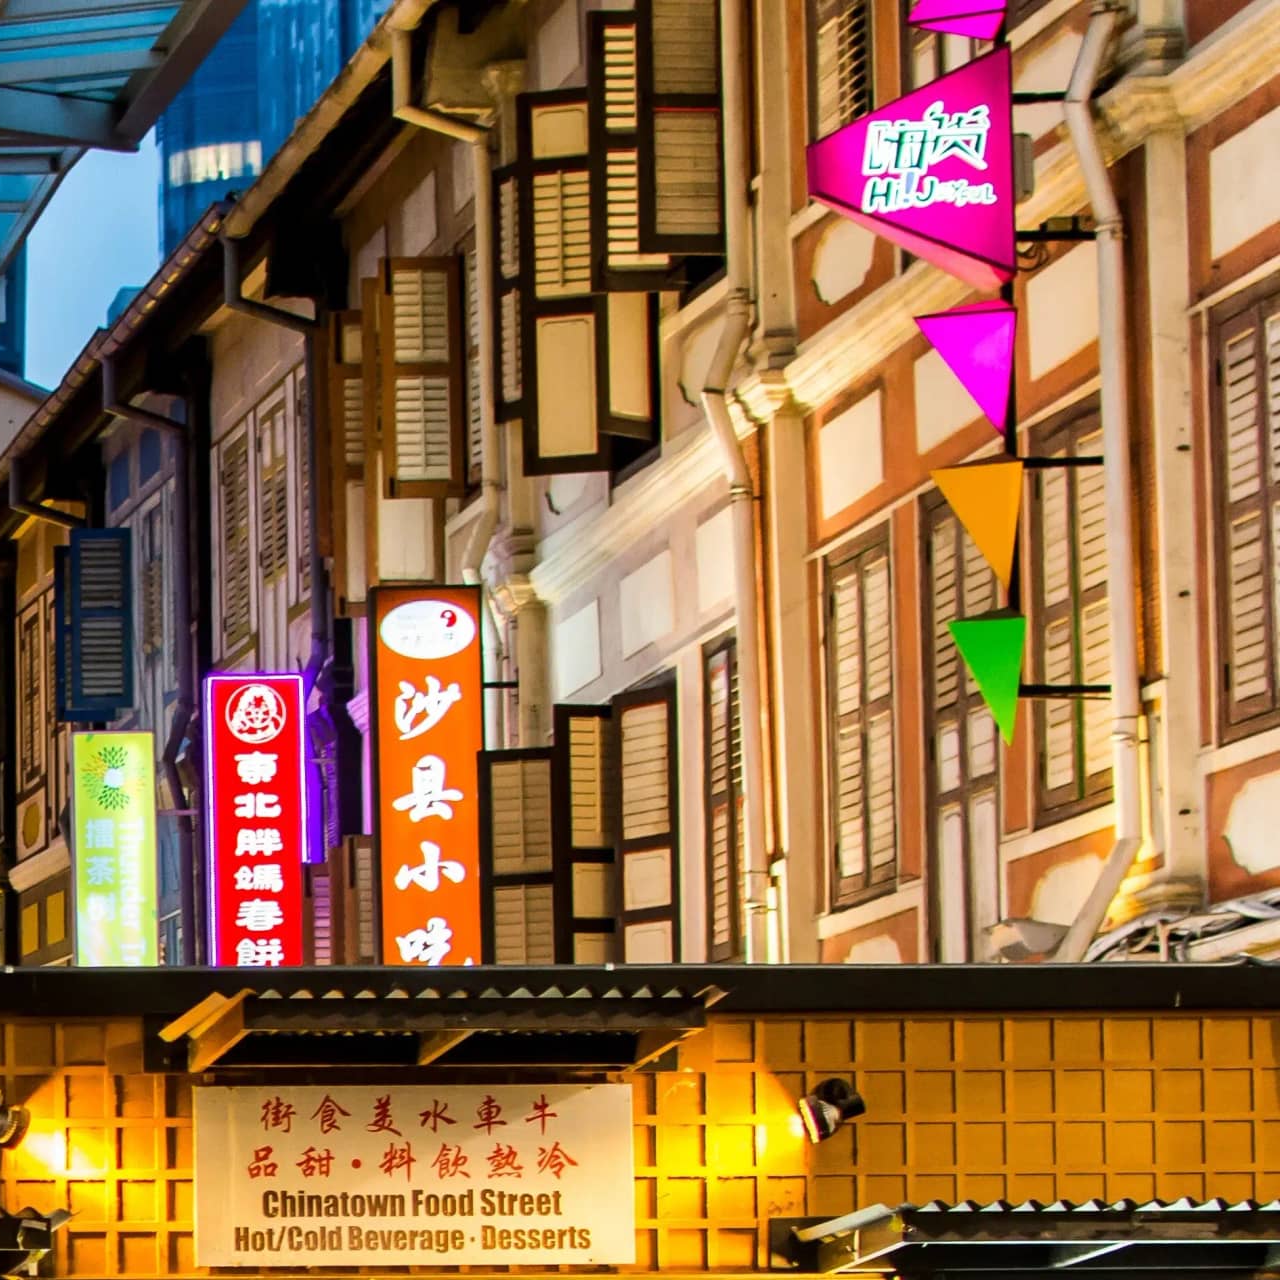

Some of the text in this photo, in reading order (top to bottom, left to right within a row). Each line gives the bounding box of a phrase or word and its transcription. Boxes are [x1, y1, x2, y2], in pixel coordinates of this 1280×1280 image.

[261, 1188, 562, 1219] Chinatown Food Street
[234, 1225, 591, 1253] Hot/Cold Beverage Desserts
